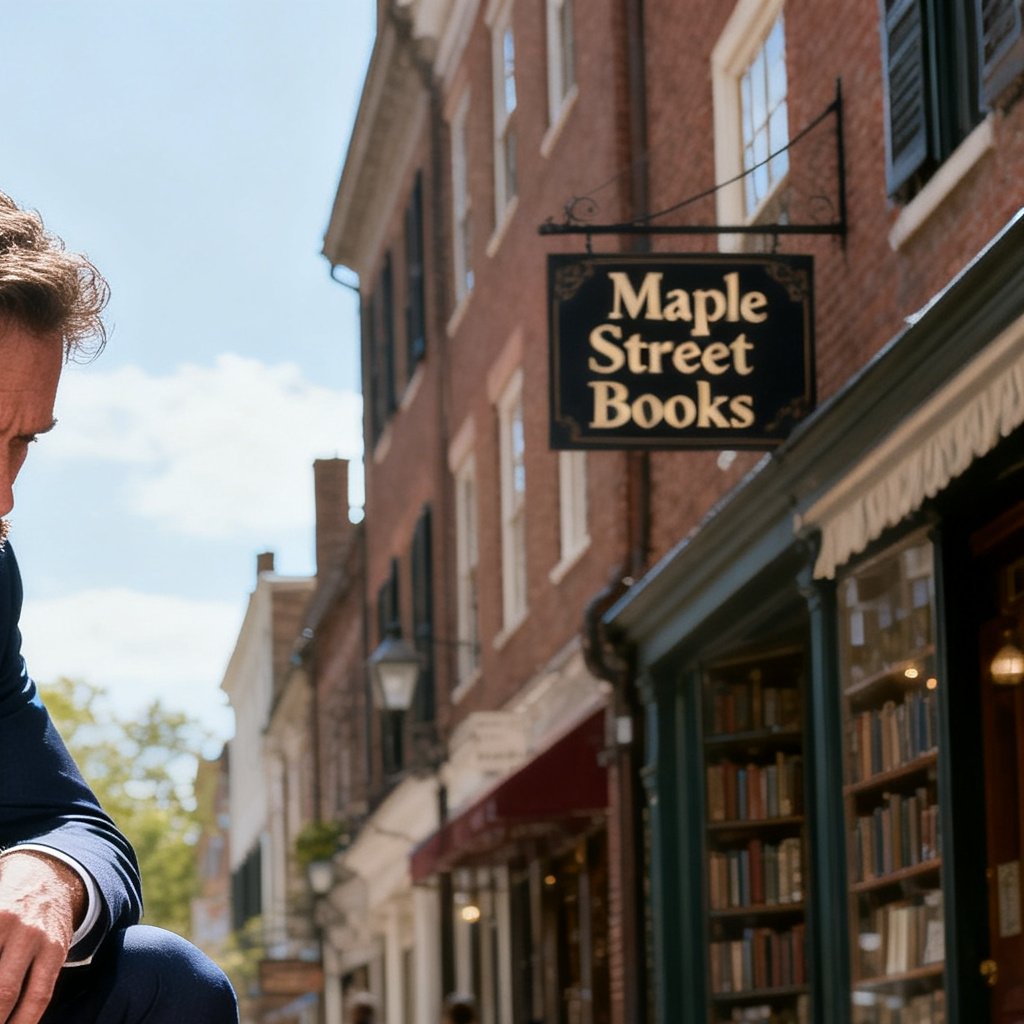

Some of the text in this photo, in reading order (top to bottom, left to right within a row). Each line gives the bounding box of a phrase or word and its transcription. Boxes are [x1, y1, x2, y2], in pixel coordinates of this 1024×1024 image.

[607, 271, 769, 337] Maple
[587, 323, 755, 376] Street
[587, 379, 756, 430] Books
